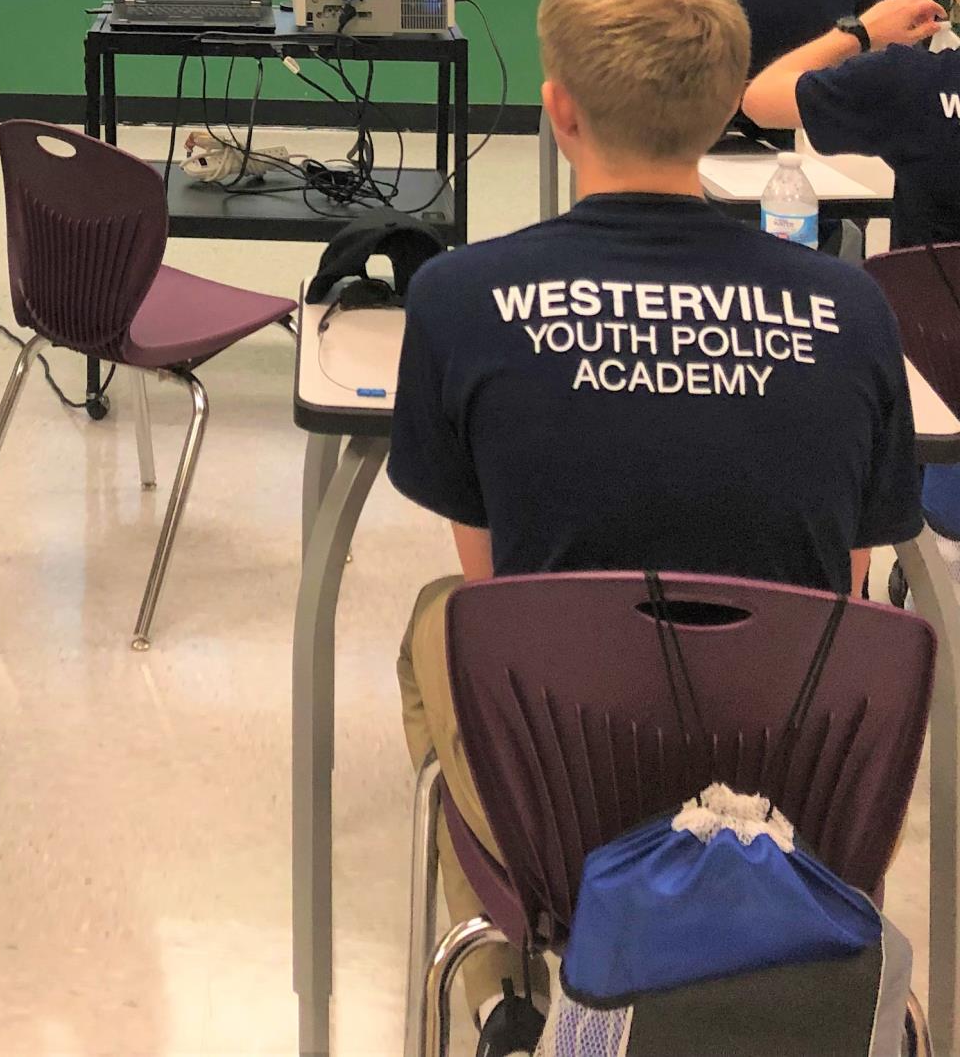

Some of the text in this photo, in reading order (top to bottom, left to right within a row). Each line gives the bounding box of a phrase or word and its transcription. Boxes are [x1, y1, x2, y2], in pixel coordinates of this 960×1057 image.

[492, 279, 840, 334] WESTERVILLE
[523, 322, 816, 364] YOUTH POLICE
[572, 358, 774, 397] ACADEMY
